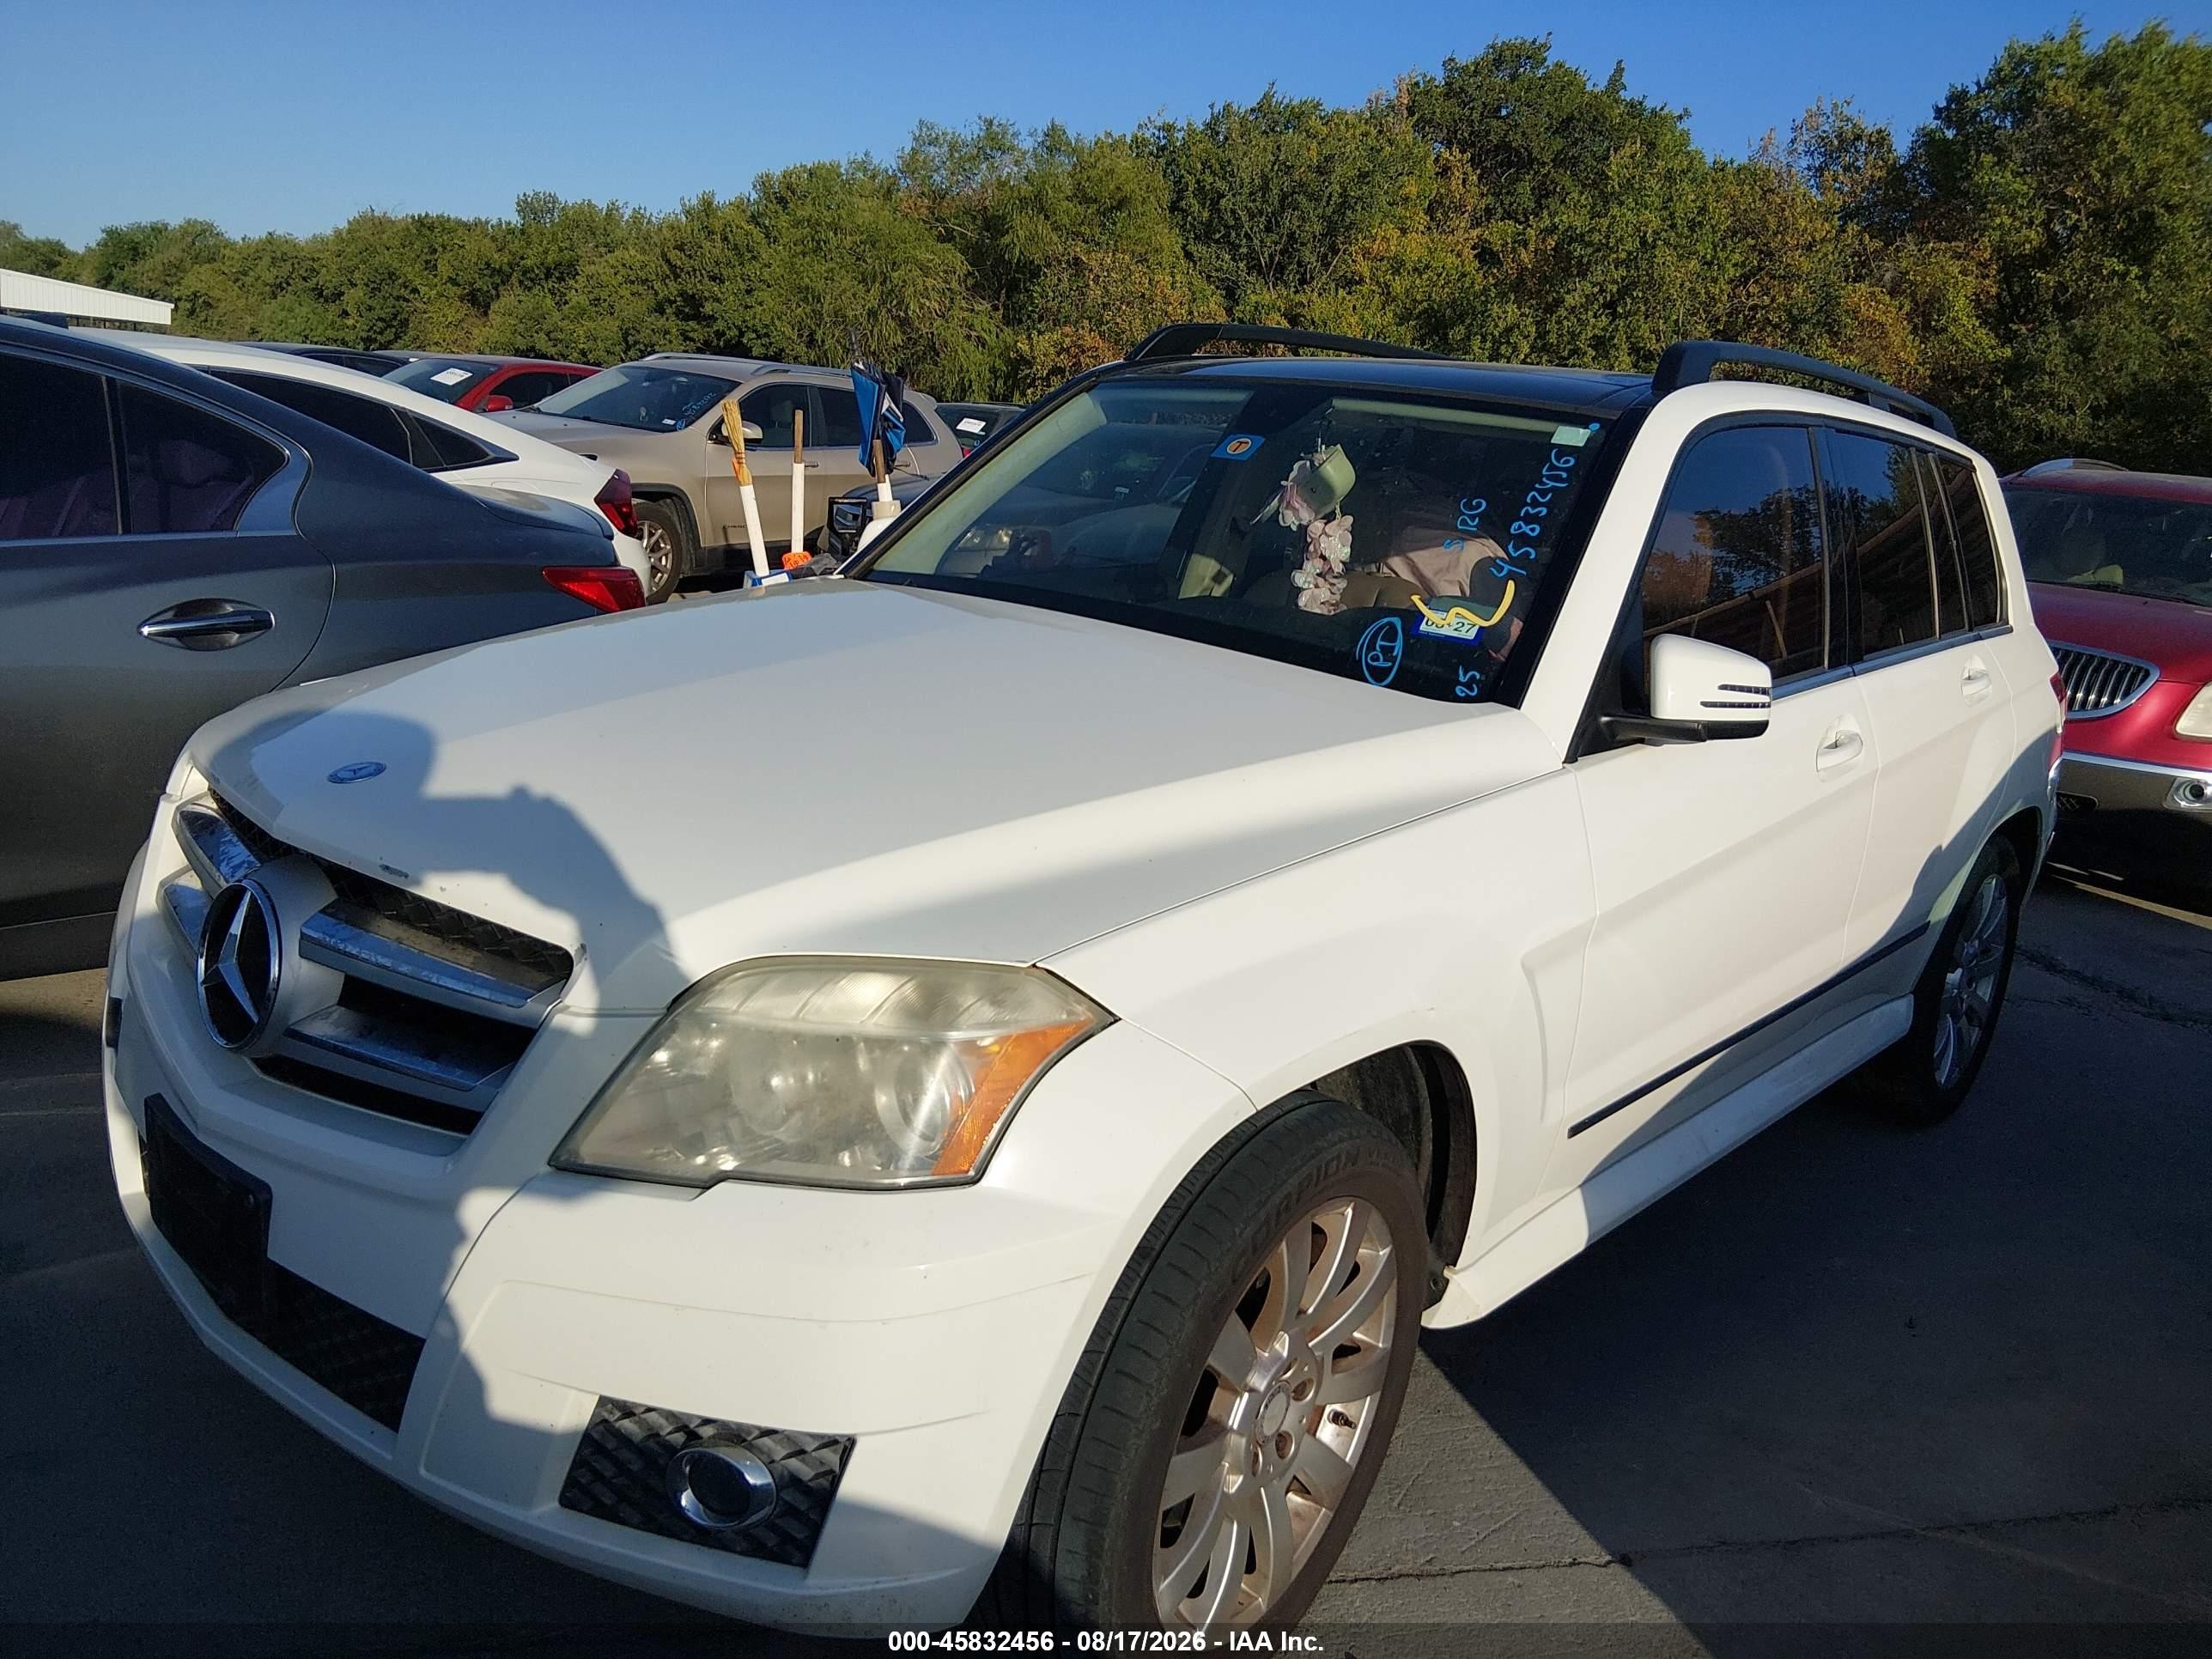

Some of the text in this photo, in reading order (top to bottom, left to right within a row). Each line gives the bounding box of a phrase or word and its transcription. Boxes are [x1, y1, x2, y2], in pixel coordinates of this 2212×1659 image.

[1488, 448, 1575, 577] 45832456
[1453, 621, 1478, 634] 27
[1455, 665, 1481, 697] 25
